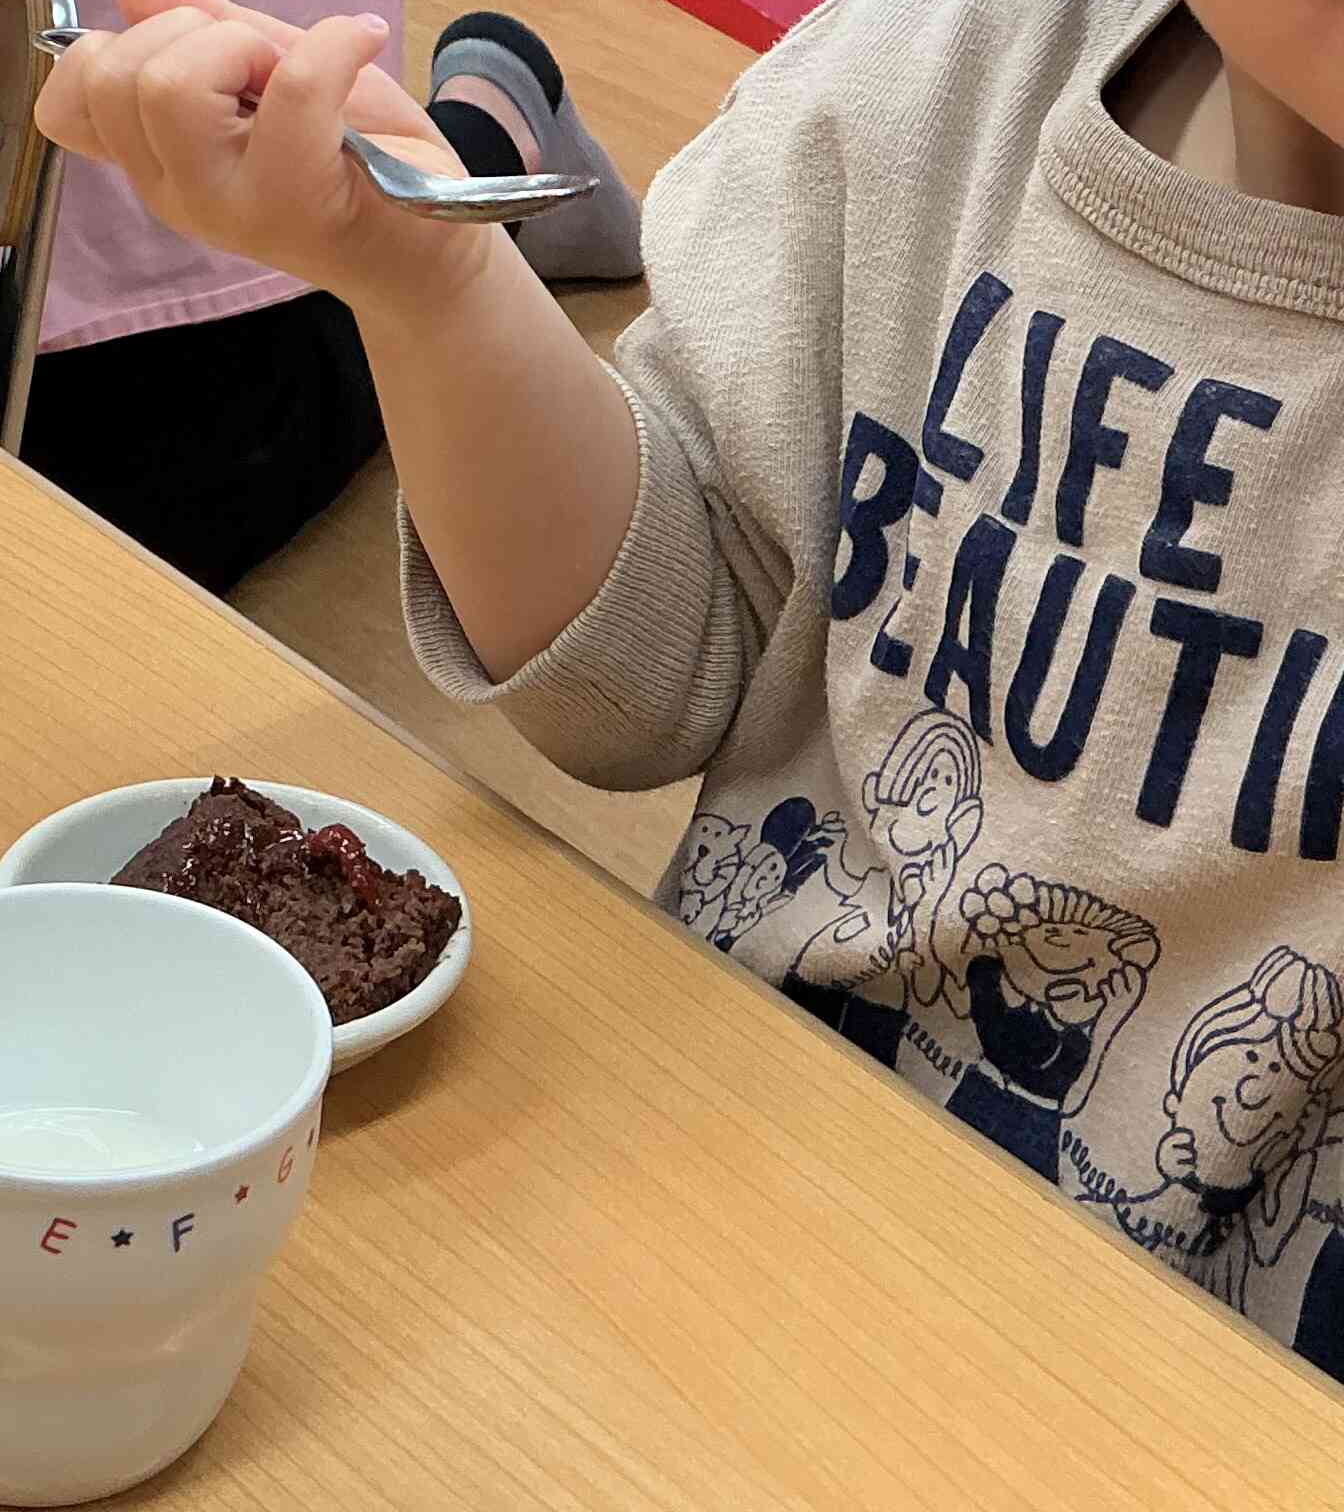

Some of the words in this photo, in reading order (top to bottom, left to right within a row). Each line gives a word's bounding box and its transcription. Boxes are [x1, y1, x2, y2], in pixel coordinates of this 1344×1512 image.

[921, 271, 1283, 594] LIFE
[39, 1216, 78, 1256] E
[171, 1212, 196, 1253] F
